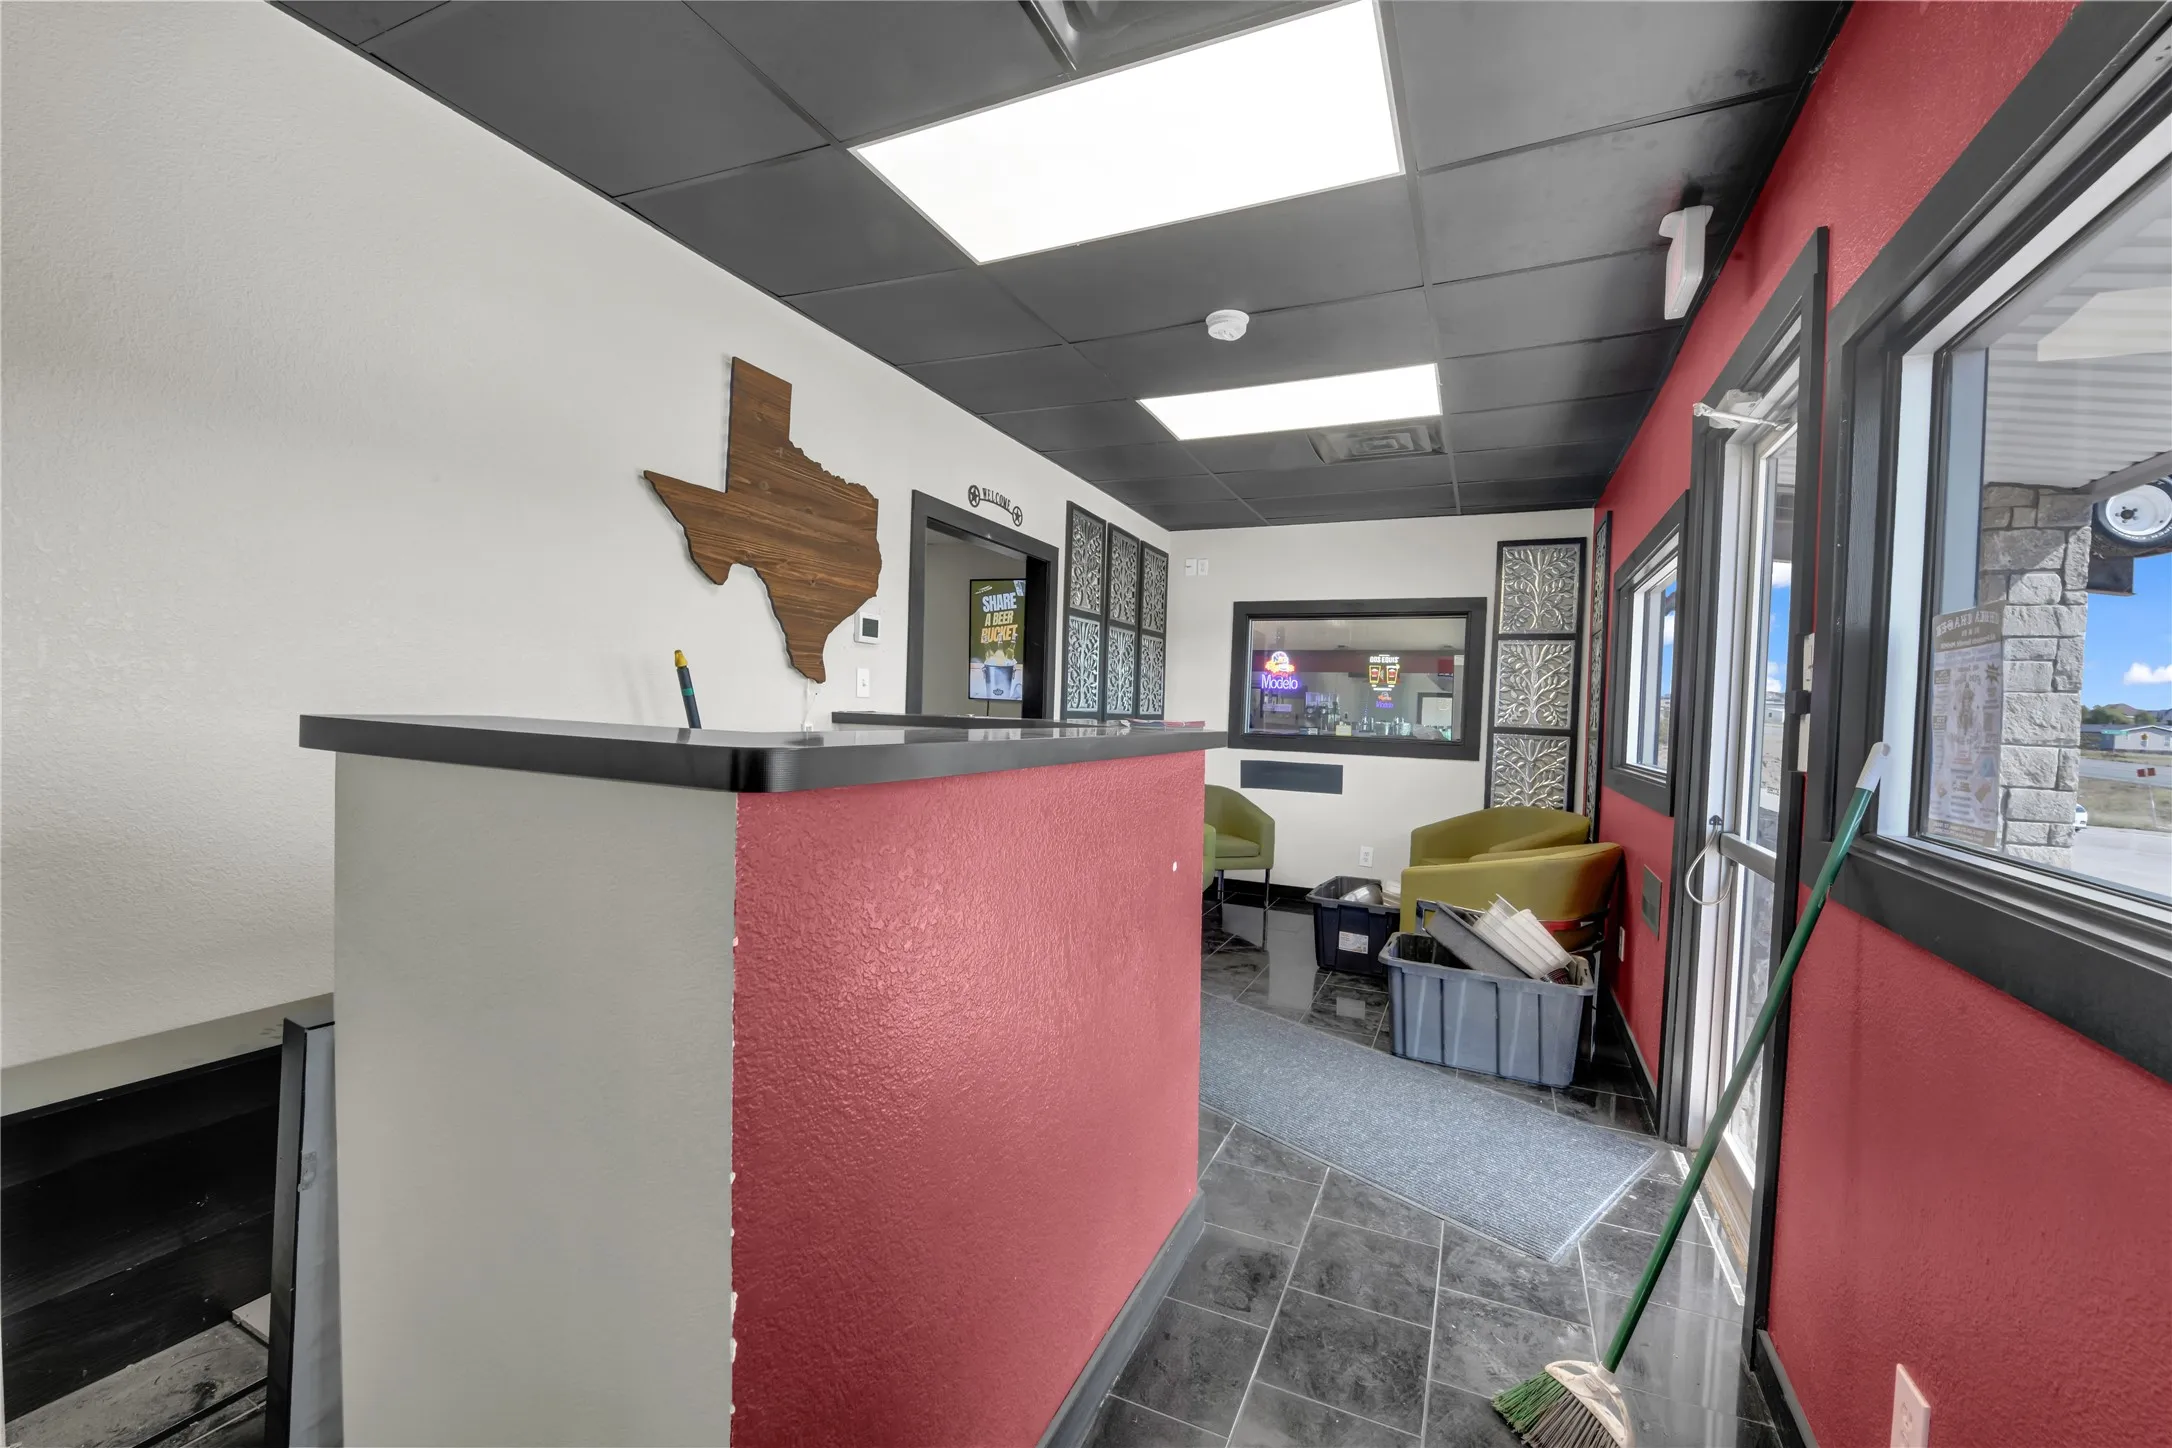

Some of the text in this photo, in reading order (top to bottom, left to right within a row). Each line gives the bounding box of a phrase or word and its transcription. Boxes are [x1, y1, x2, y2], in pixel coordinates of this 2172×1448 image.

[982, 487, 1011, 510] WELCOME
[982, 592, 1017, 612] SHARE
[984, 610, 1014, 626] A BEER
[980, 624, 1018, 643] BUCKET
[1261, 673, 1298, 690] Modelo
